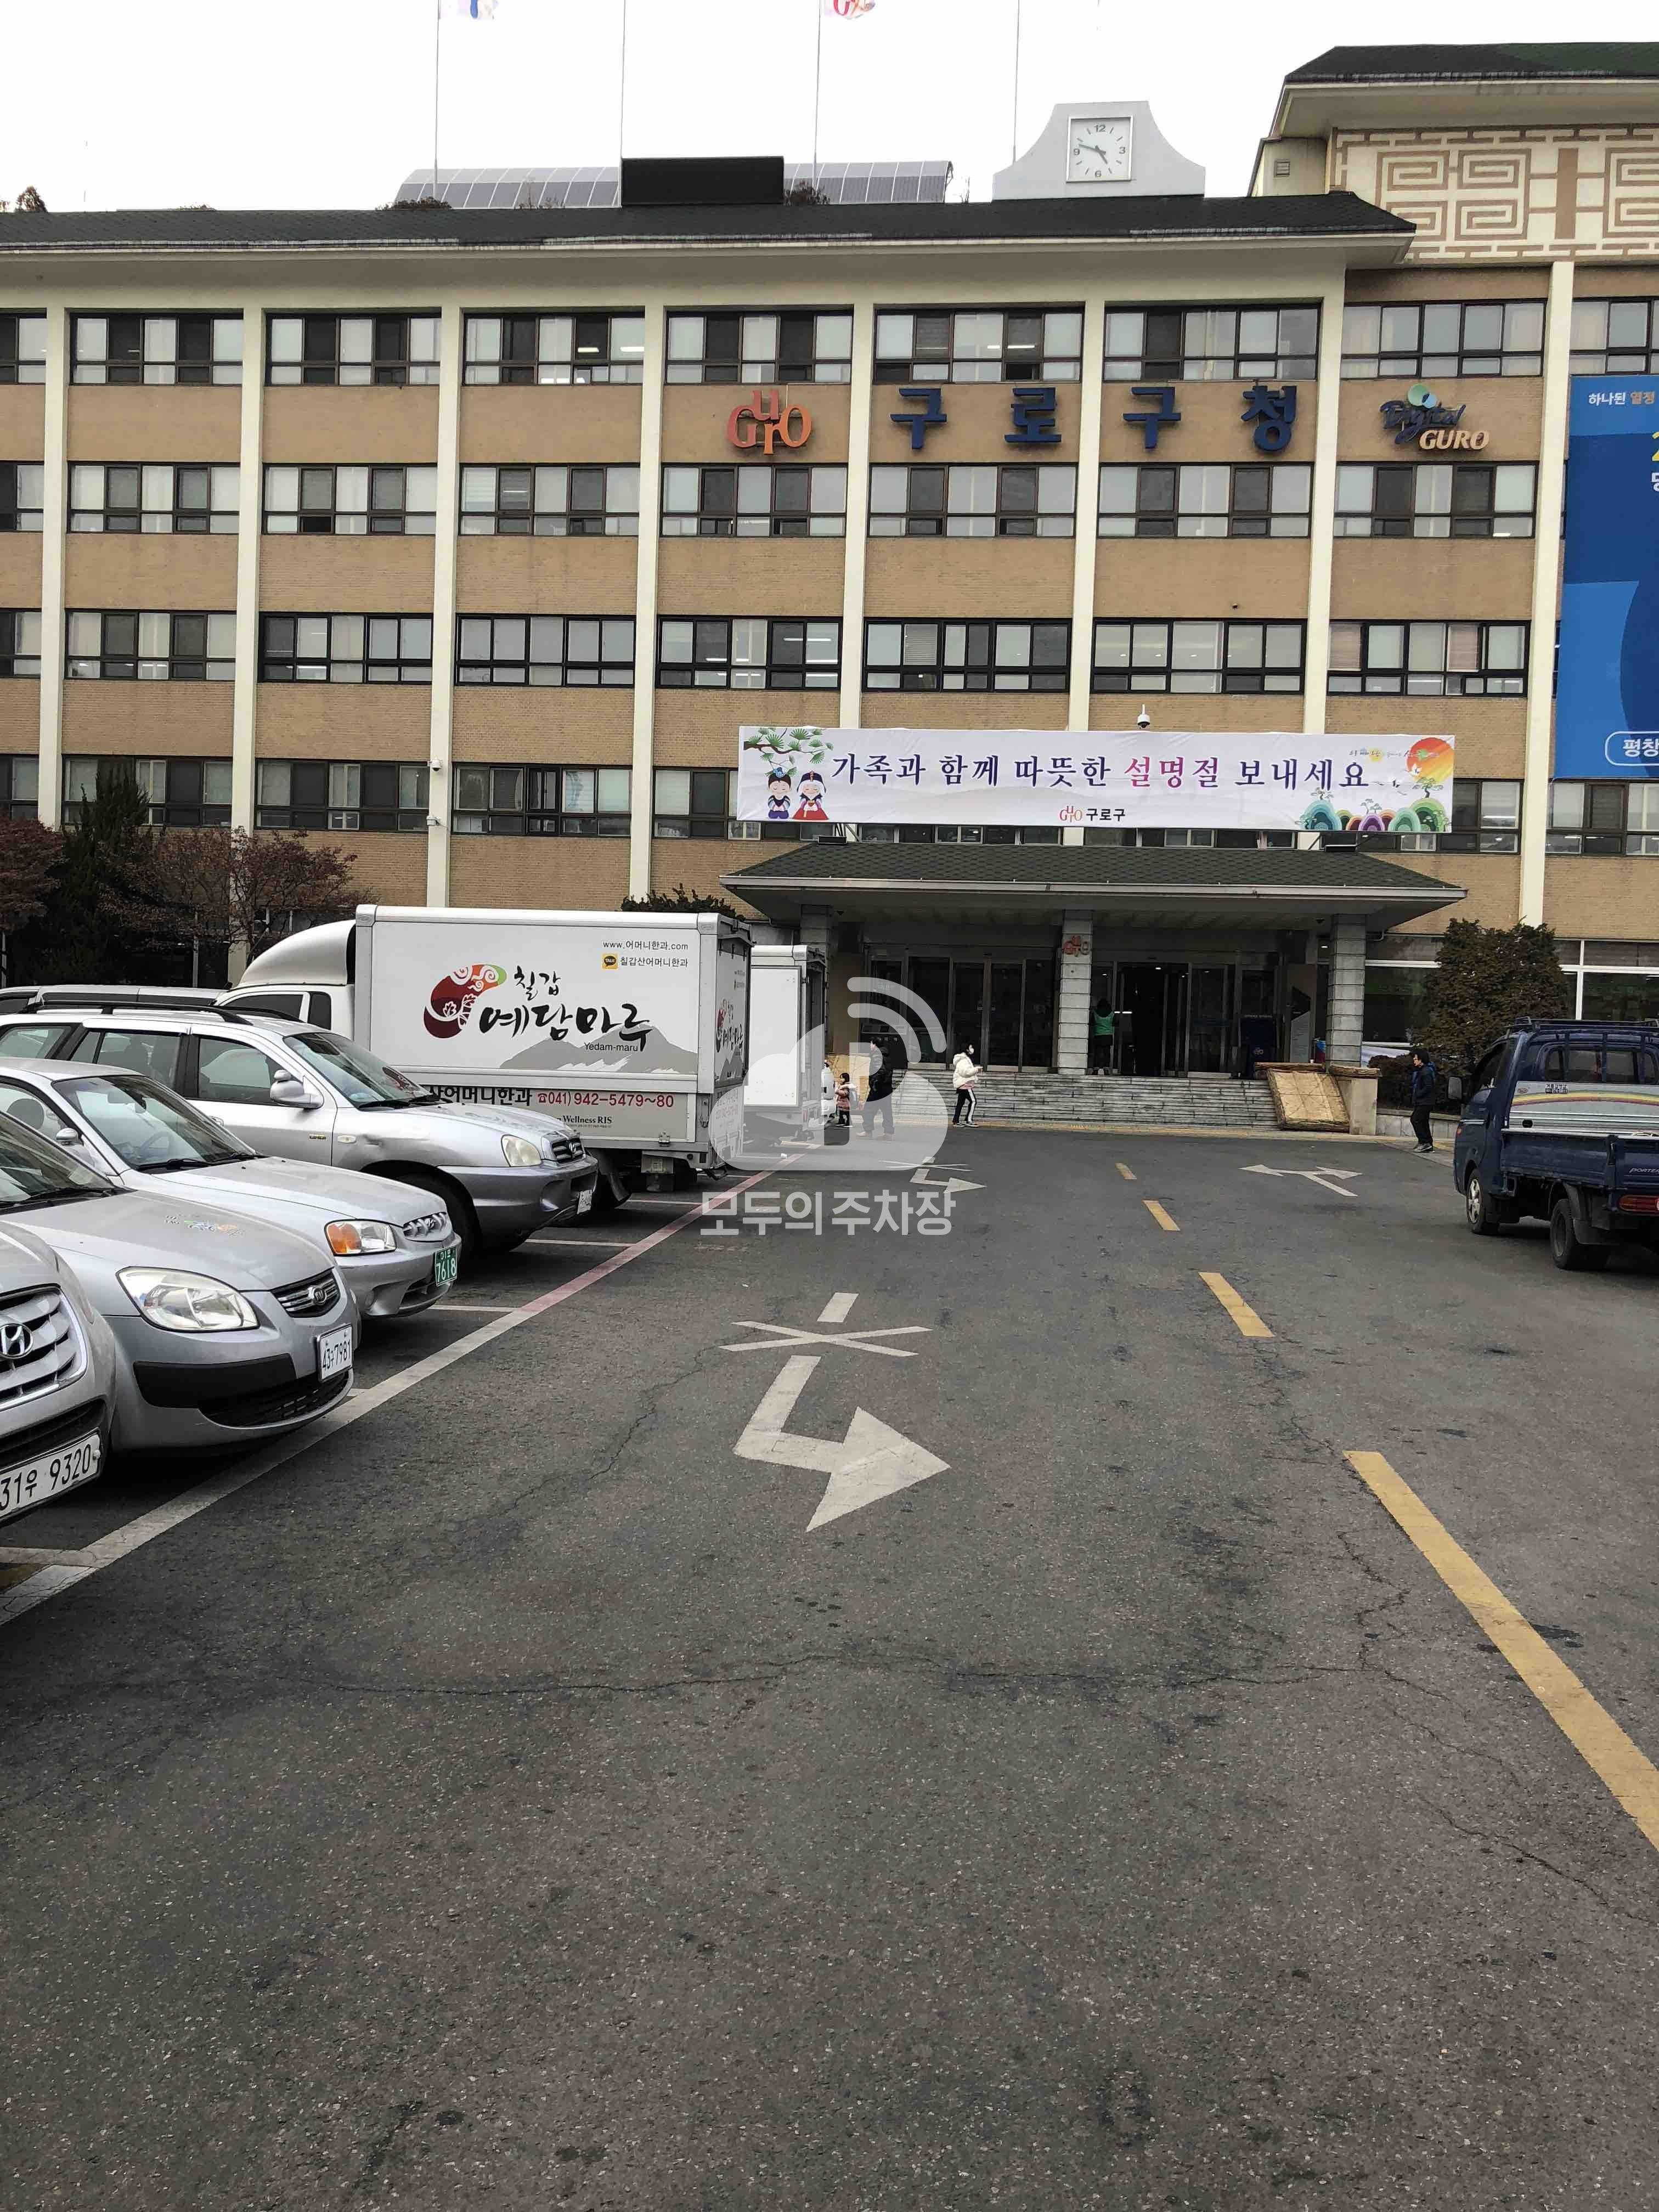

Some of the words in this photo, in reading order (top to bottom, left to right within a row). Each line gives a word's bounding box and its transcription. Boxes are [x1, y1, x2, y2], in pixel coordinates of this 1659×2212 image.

[1588, 392, 1626, 406] 하나된
[890, 385, 1297, 451] 구로구청
[1419, 430, 1490, 450] GURO
[1623, 738, 1659, 758] 평창
[832, 753, 926, 785] 가족과
[939, 755, 998, 786] 함께
[1014, 756, 1110, 787] 따뜻한
[1124, 757, 1219, 788] 설명절
[1235, 759, 1369, 791] 보내세요
[1086, 808, 1126, 822] 구로구
[602, 940, 689, 950] www.어머니한과.com
[620, 956, 689, 967] 칠갑산어머니한과
[514, 966, 561, 1001] 칠갑
[479, 1002, 653, 1052] 예담마루
[584, 1042, 638, 1052] Yedam-maru
[562, 1115, 596, 1124] Wellness
[597, 1116, 612, 1124] RIS
[436, 1257, 456, 1283] 7618
[0, 1469, 37, 1510] 31우
[49, 1443, 91, 1491] 9320
